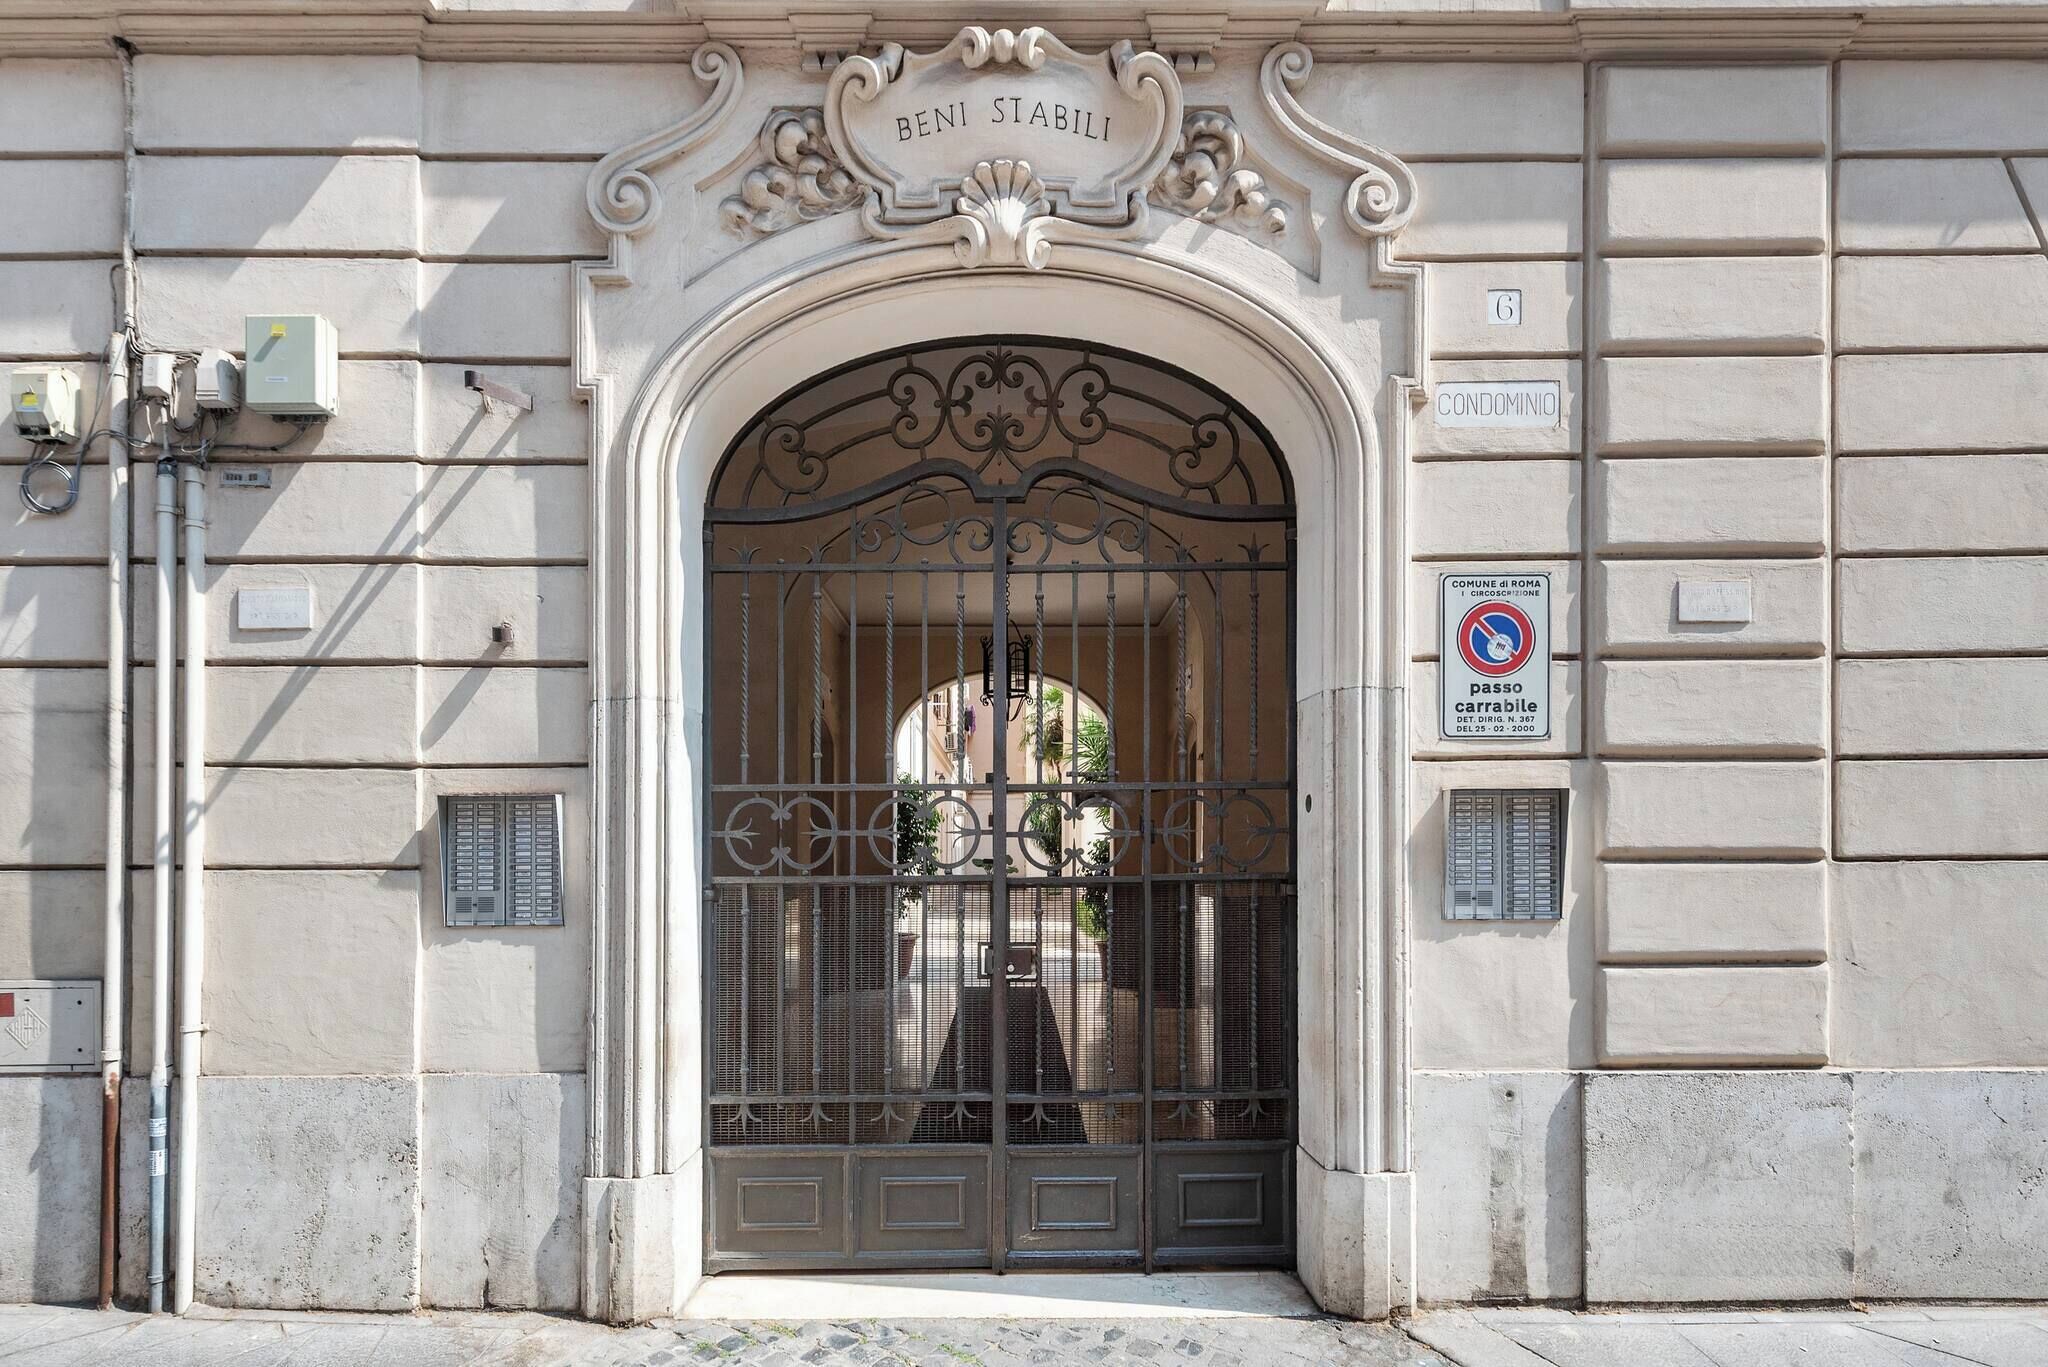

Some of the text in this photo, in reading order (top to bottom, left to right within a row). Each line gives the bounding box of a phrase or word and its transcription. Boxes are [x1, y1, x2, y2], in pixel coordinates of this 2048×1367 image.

[896, 98, 1111, 142] BENI STABILI
[1496, 294, 1513, 321] 6
[1438, 392, 1556, 416] CONDOMINIO
[1452, 580, 1541, 588] COMUNE di ROMA
[1470, 683, 1523, 696] passo
[1455, 699, 1538, 713] carrabile
